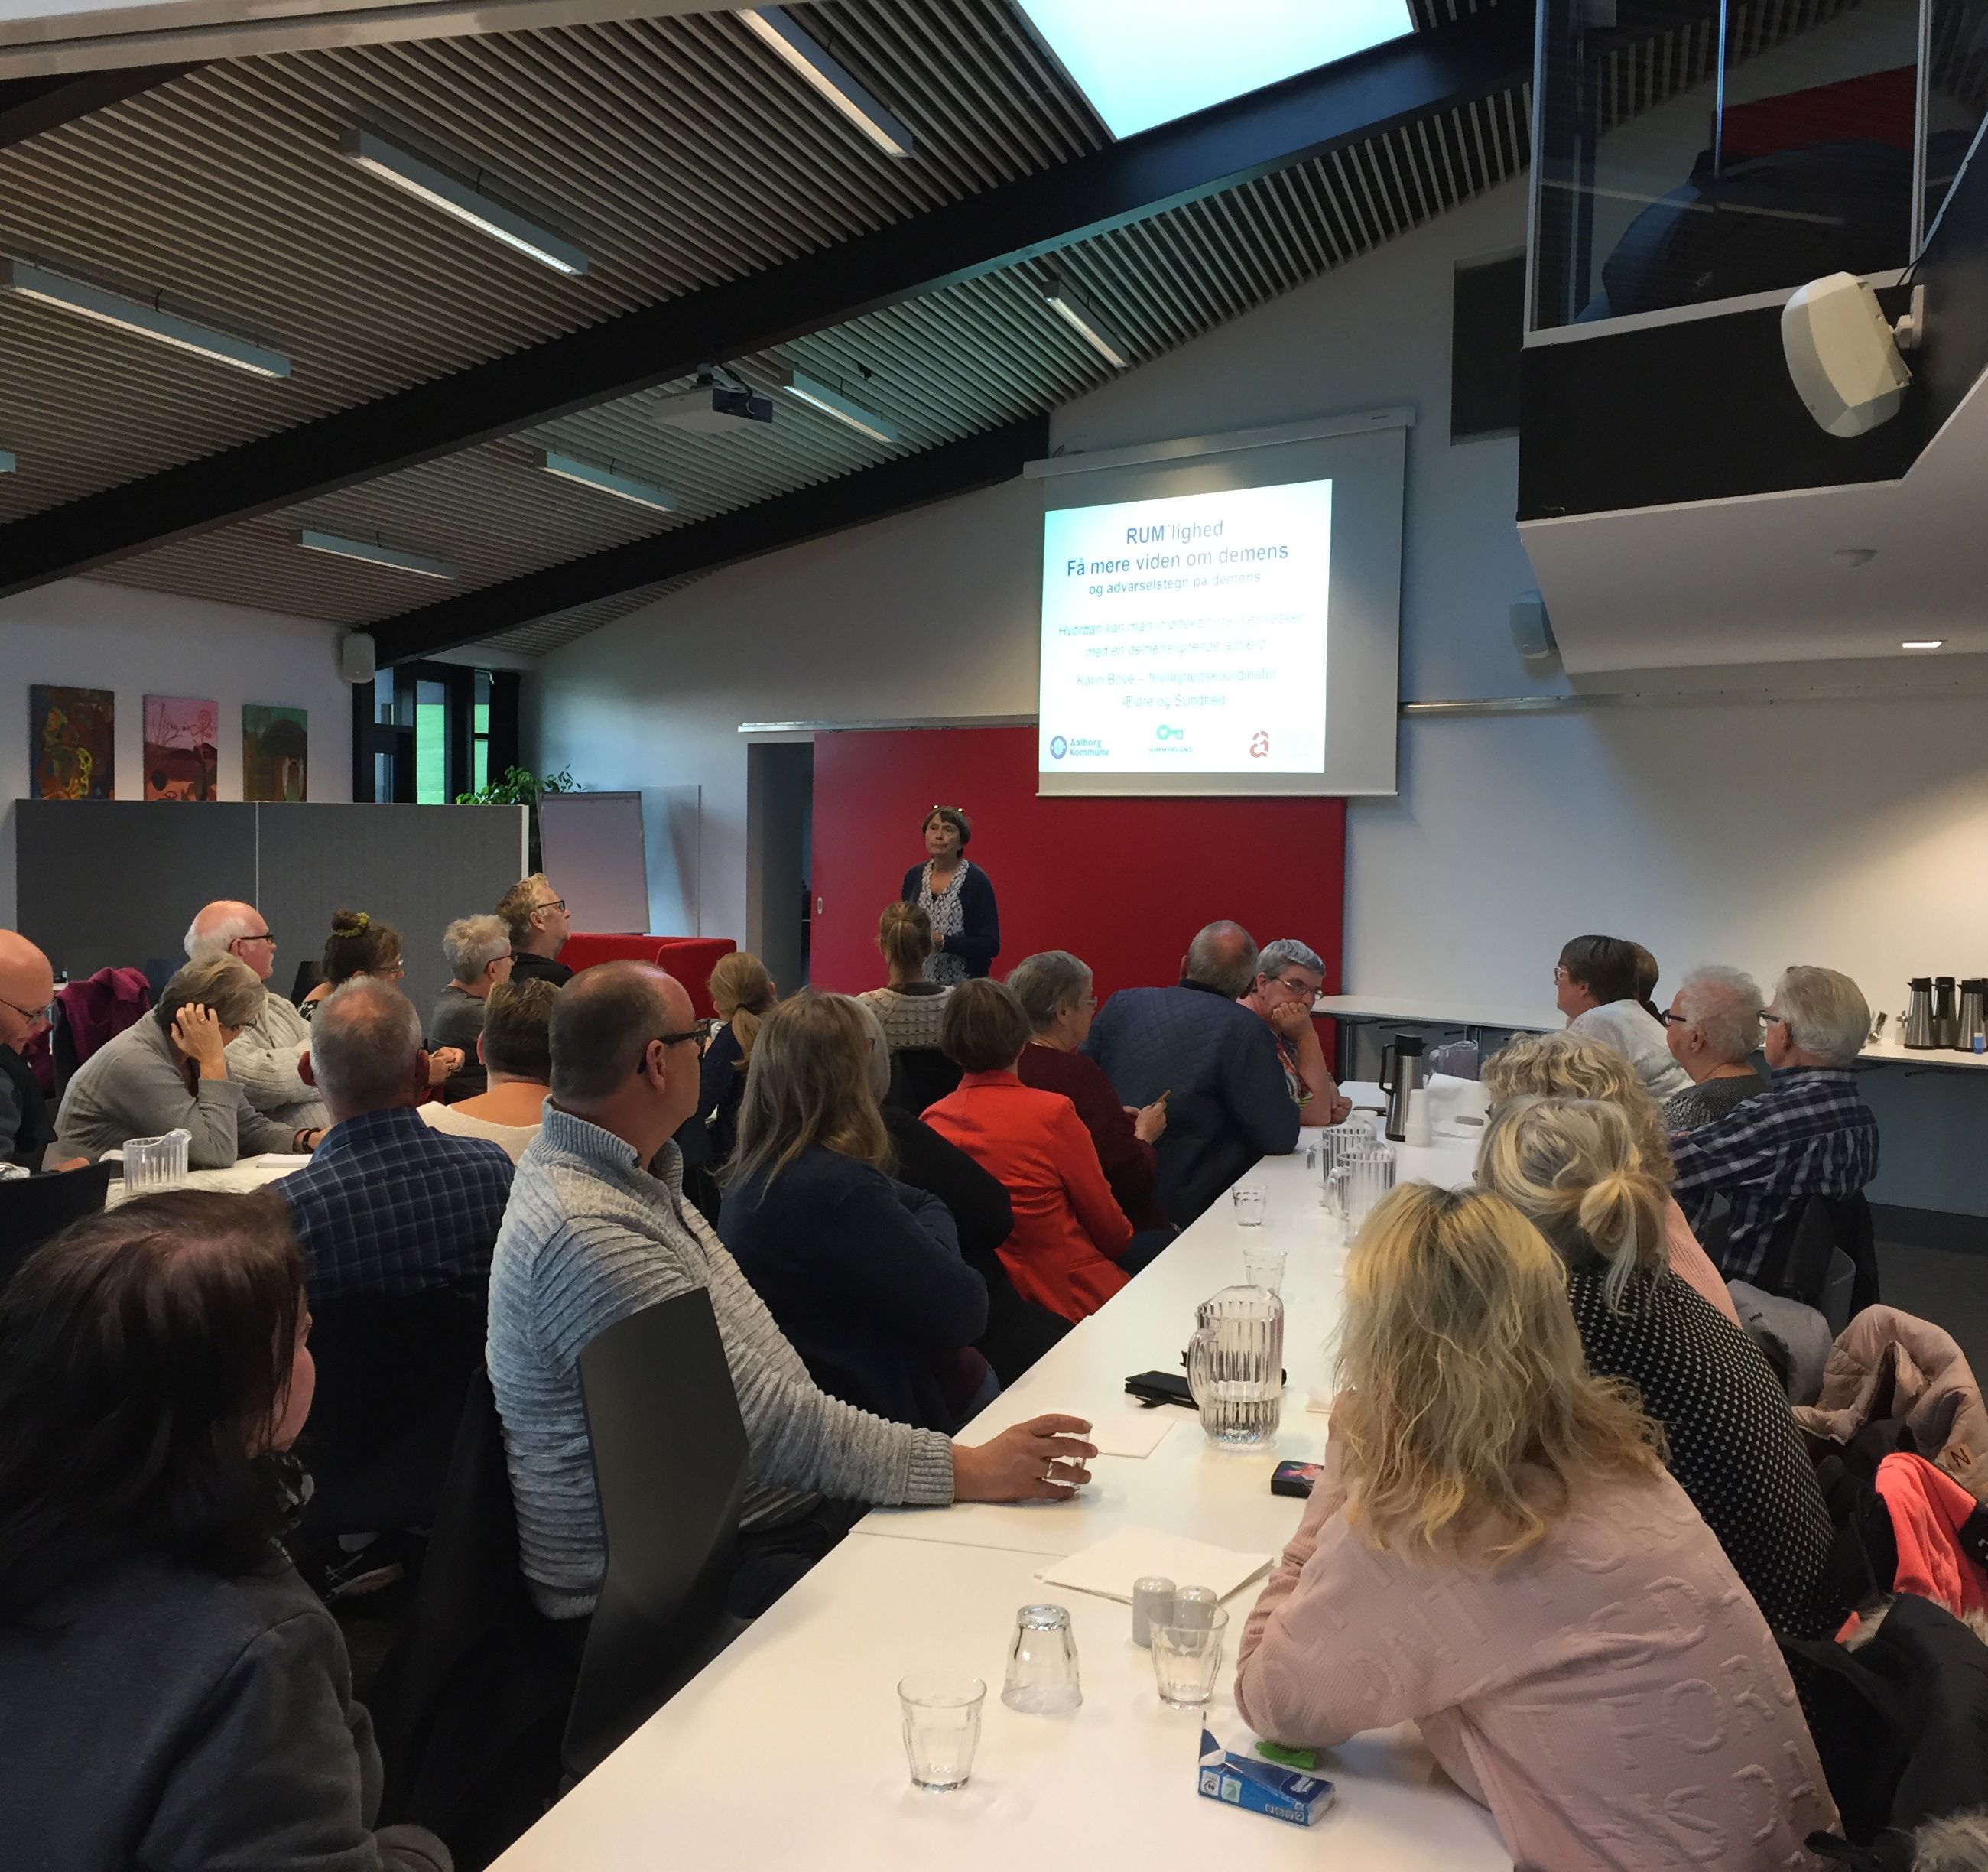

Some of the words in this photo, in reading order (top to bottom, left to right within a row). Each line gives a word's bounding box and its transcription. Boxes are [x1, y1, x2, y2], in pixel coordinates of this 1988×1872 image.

[1067, 557, 1085, 576] Få
[1090, 557, 1130, 574] mere
[1136, 553, 1180, 570] viden
[1187, 551, 1212, 567] om
[1219, 544, 1288, 564] demens
[1089, 584, 1103, 597] og
[1107, 576, 1188, 593] advarselstegn
[1212, 573, 1260, 586] demens
[1070, 737, 1102, 748] Aalborg
[1070, 748, 1110, 756] Kommune
